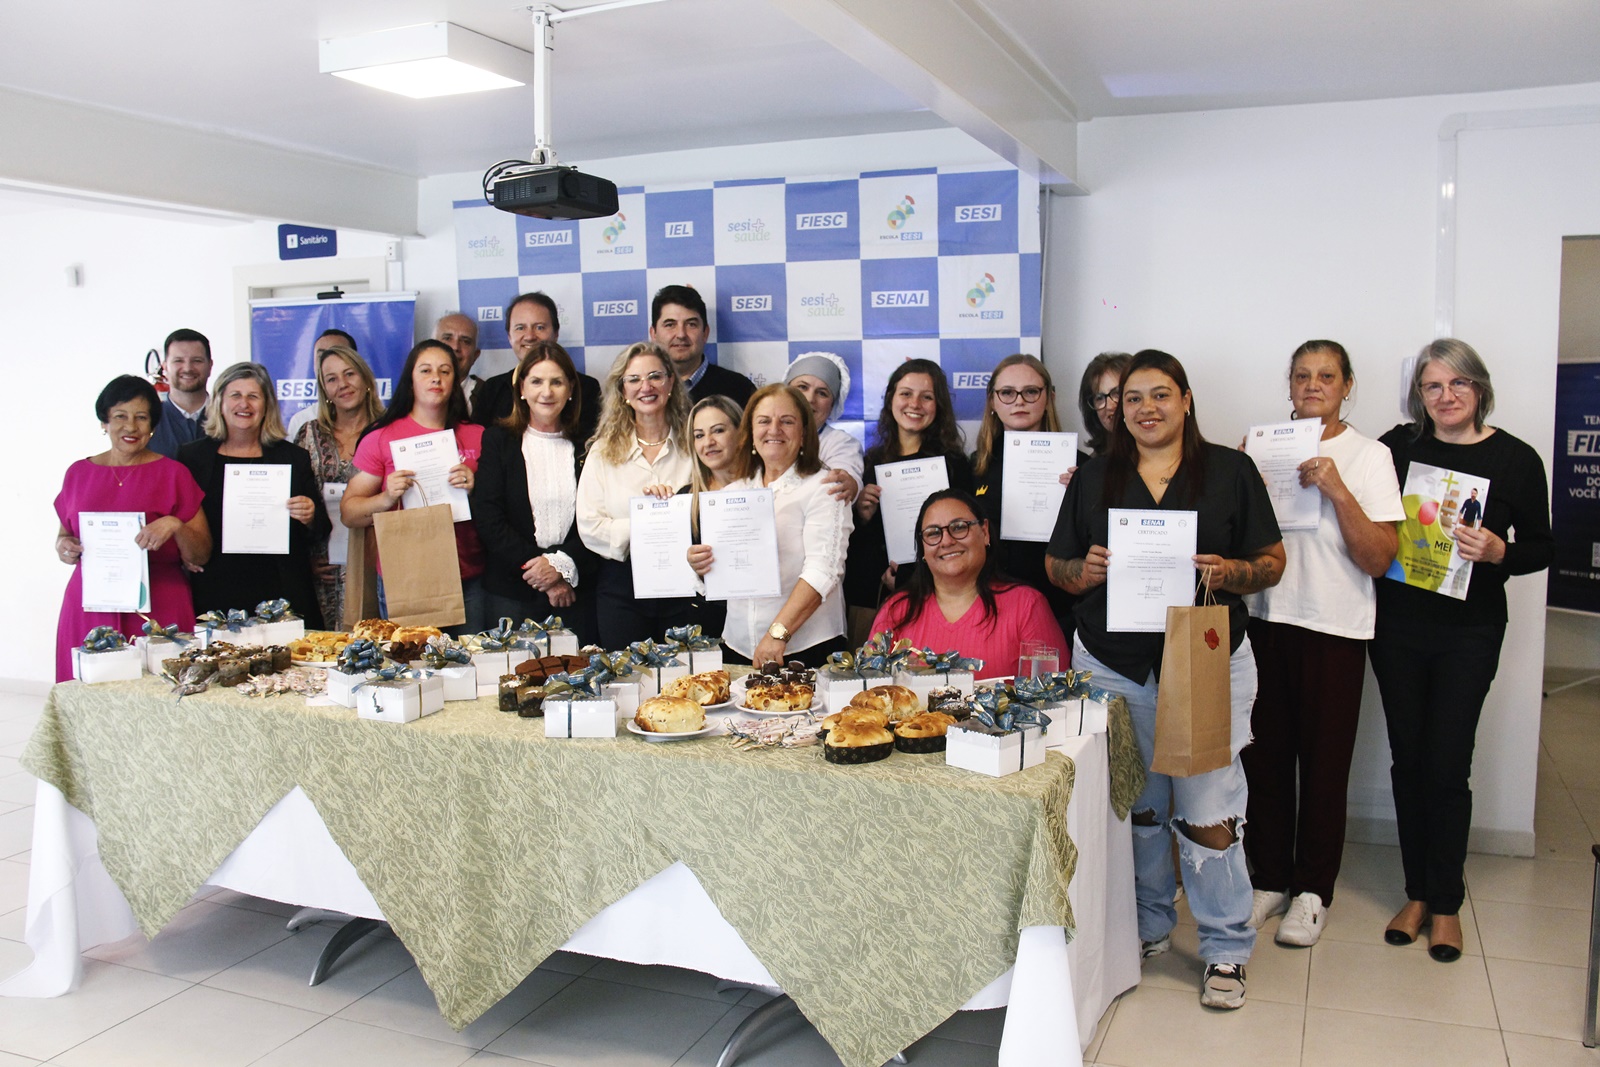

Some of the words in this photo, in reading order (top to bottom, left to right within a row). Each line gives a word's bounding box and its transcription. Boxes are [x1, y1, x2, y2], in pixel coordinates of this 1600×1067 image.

[960, 207, 997, 220] SESI
[801, 214, 844, 227] FIESC
[669, 224, 689, 236] IEL
[902, 232, 921, 240] SESI
[299, 234, 328, 245] Sanitário
[529, 232, 568, 245] SENAI
[735, 297, 768, 309] SESI
[876, 293, 924, 305] SENAI
[481, 308, 500, 320] IEL
[597, 302, 634, 314] FIESC
[982, 311, 1002, 319] SESI
[957, 374, 992, 387] FIES
[281, 382, 318, 397] SESI
[1574, 464, 1588, 474] NA
[1568, 486, 1597, 499] VOCÊ
[1434, 540, 1452, 552] MEI
